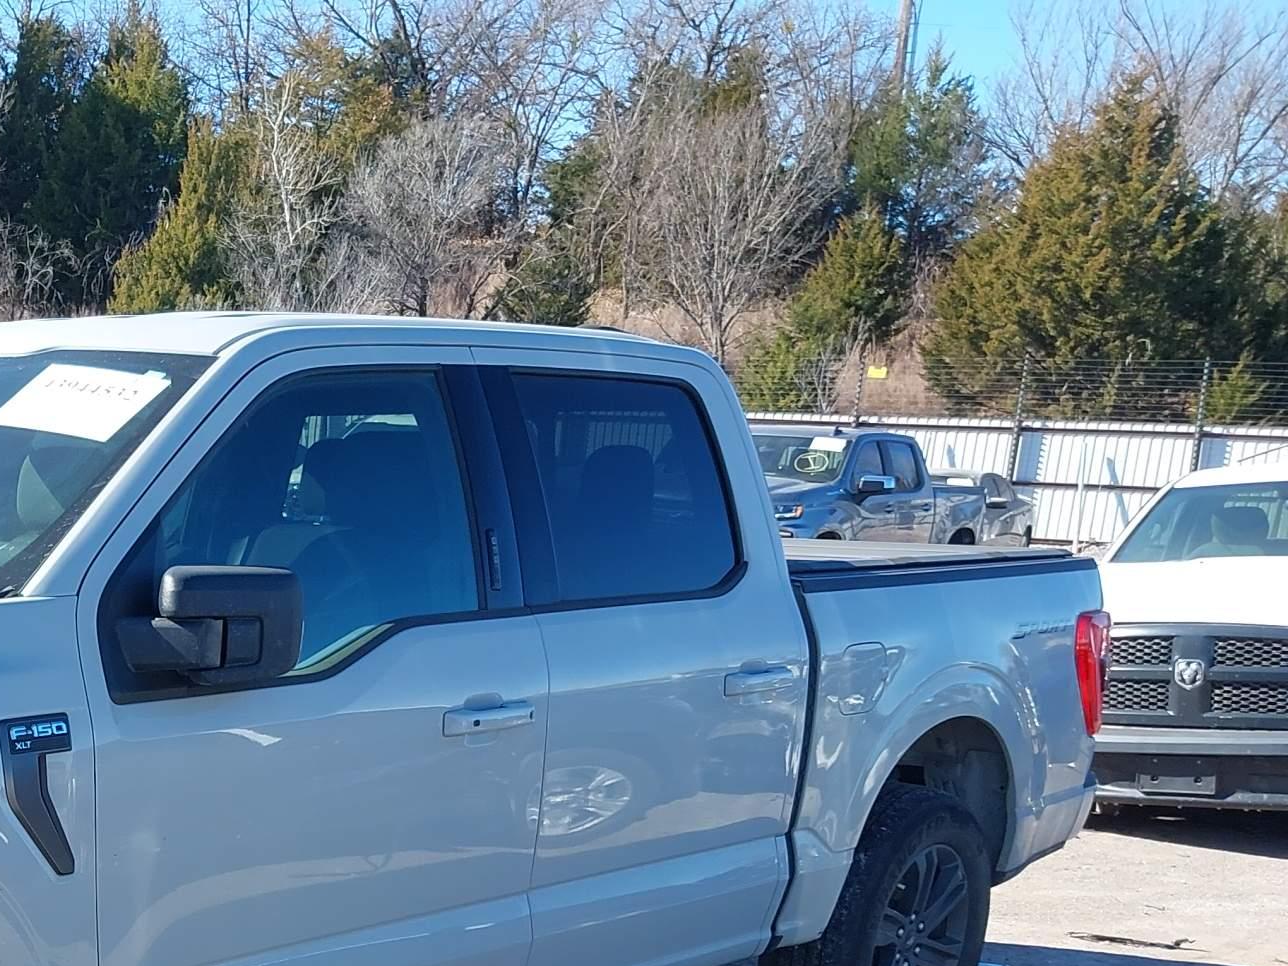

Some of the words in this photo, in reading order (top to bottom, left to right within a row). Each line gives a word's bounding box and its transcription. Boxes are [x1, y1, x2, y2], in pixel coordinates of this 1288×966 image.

[1011, 618, 1074, 640] SPORT
[10, 721, 68, 741] F-150
[15, 741, 32, 751] XLT
